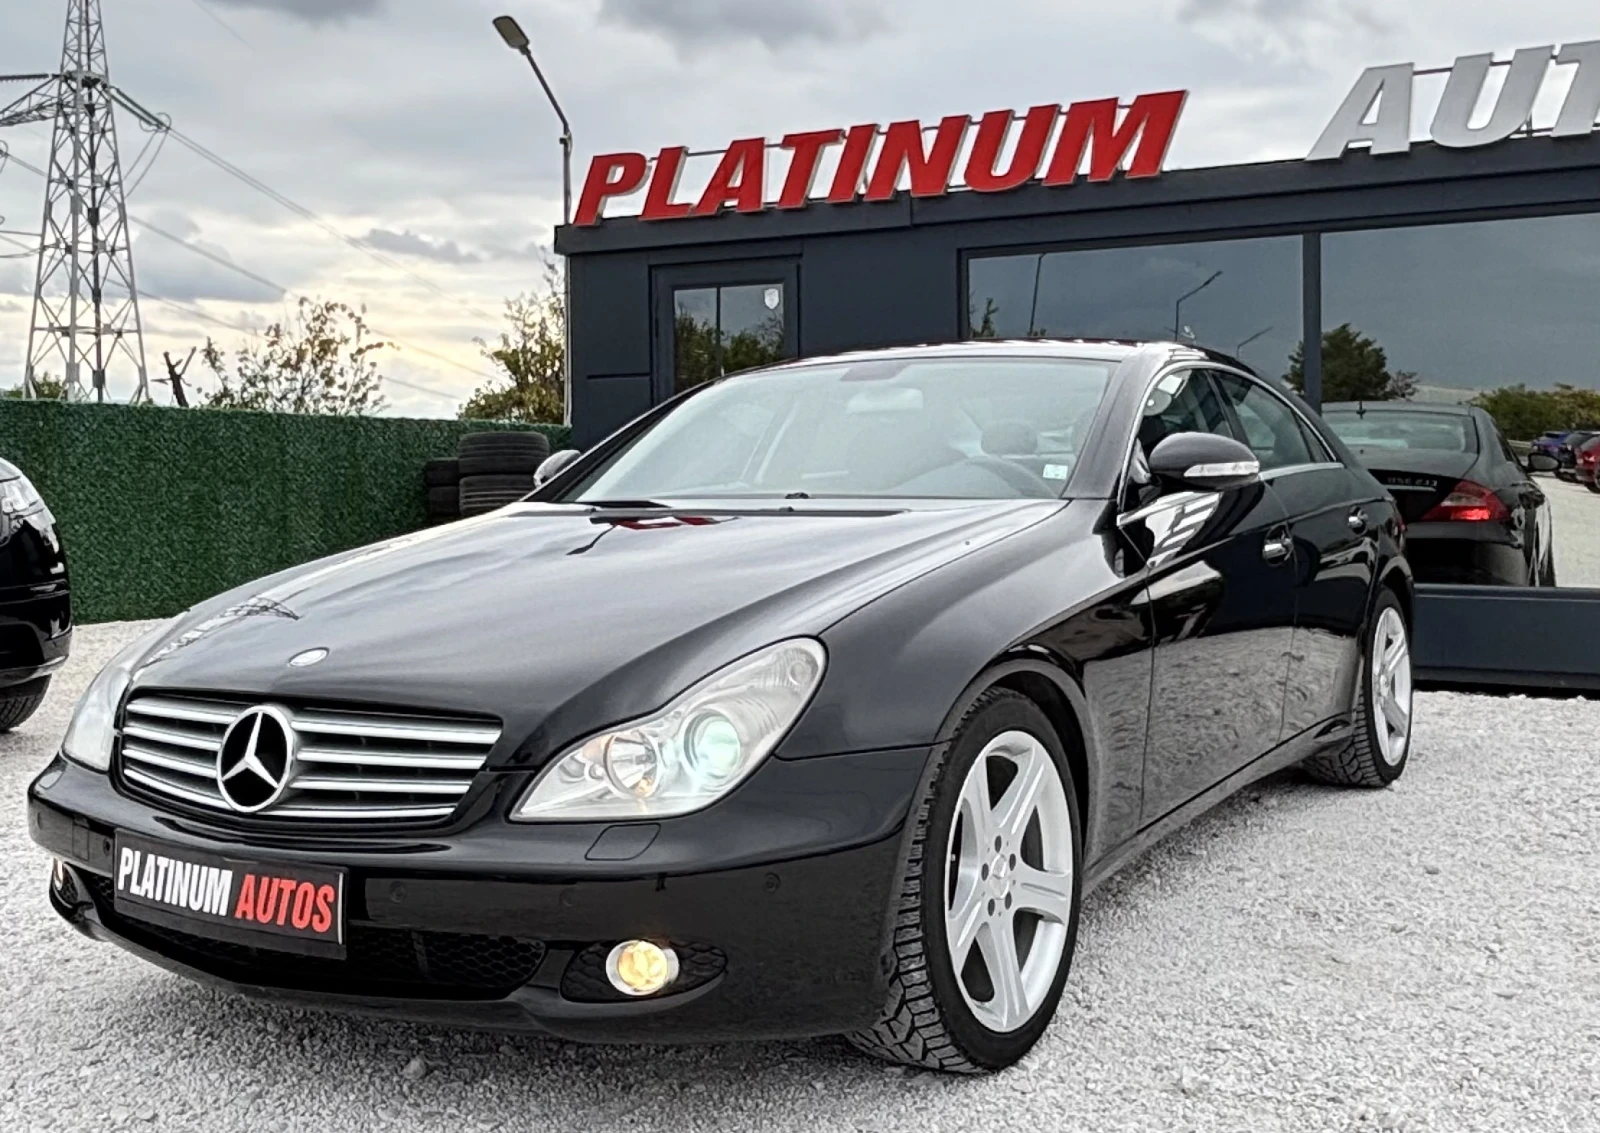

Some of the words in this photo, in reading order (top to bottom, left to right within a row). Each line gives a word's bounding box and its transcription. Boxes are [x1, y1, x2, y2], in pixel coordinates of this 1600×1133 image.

[573, 89, 1189, 226] PLATINUM
[117, 847, 233, 916] PLATINUM
[235, 874, 335, 933] AUTOS
